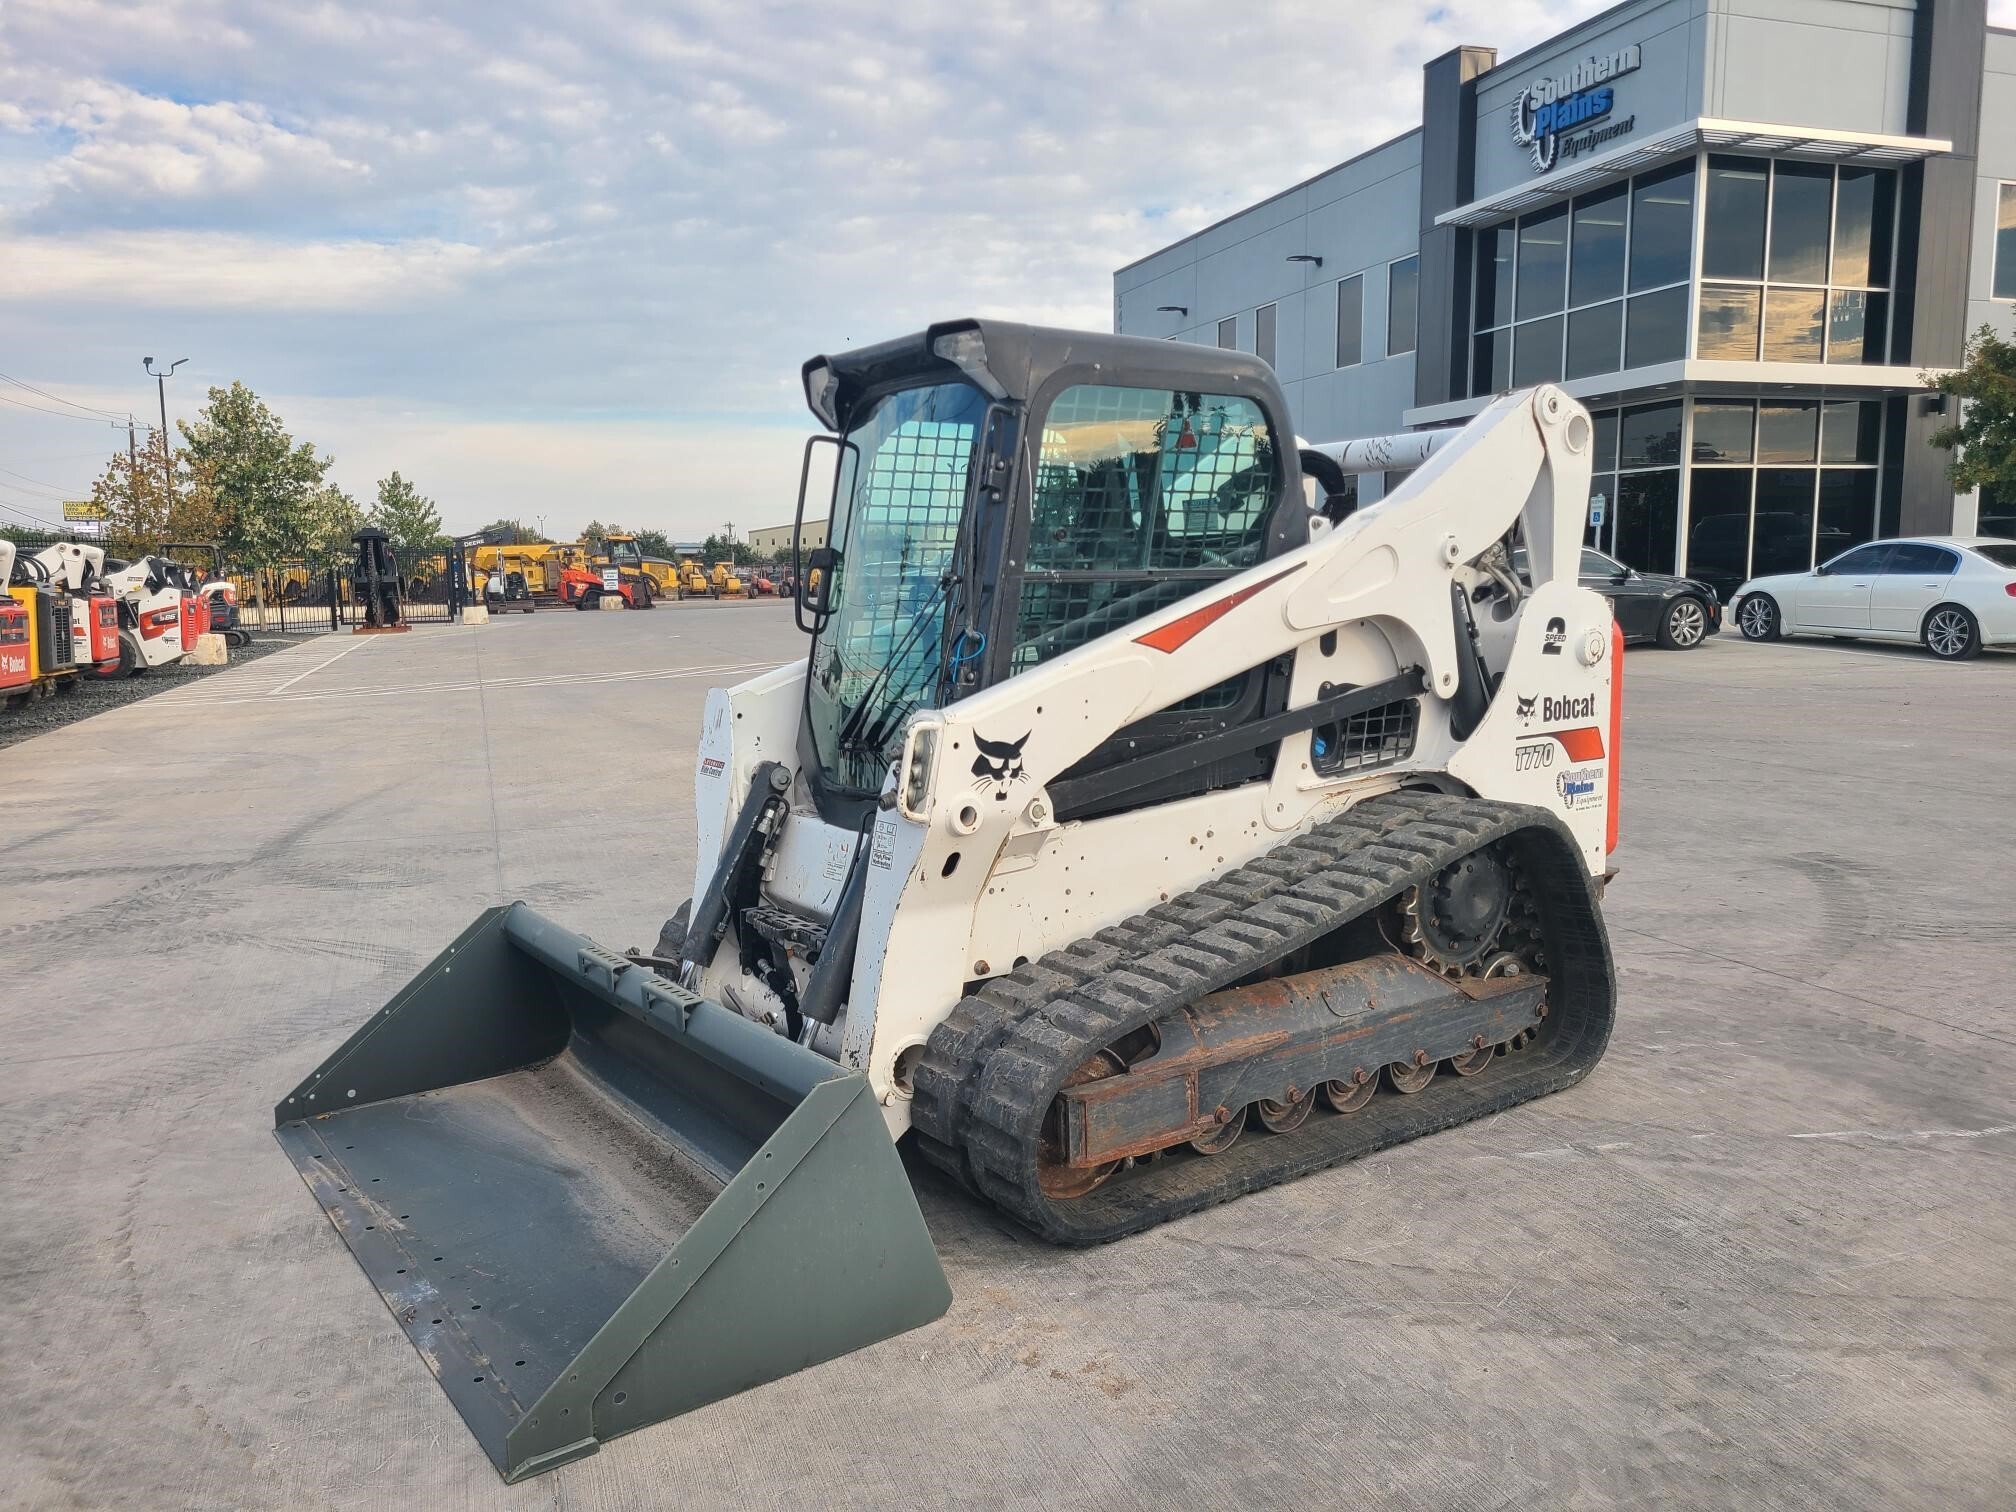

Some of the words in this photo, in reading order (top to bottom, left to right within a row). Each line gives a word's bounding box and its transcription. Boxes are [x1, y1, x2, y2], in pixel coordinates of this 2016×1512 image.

[1530, 43, 1641, 111] Southern
[1535, 85, 1614, 140] Plains
[1560, 114, 1635, 158] Equipment
[464, 539, 485, 547] DEERE
[1545, 633, 1567, 643] SPEED
[9, 656, 26, 673] Bobcat
[1543, 693, 1595, 722] Bobcat
[1515, 743, 1554, 771] T770
[1565, 768, 1603, 782] Southern
